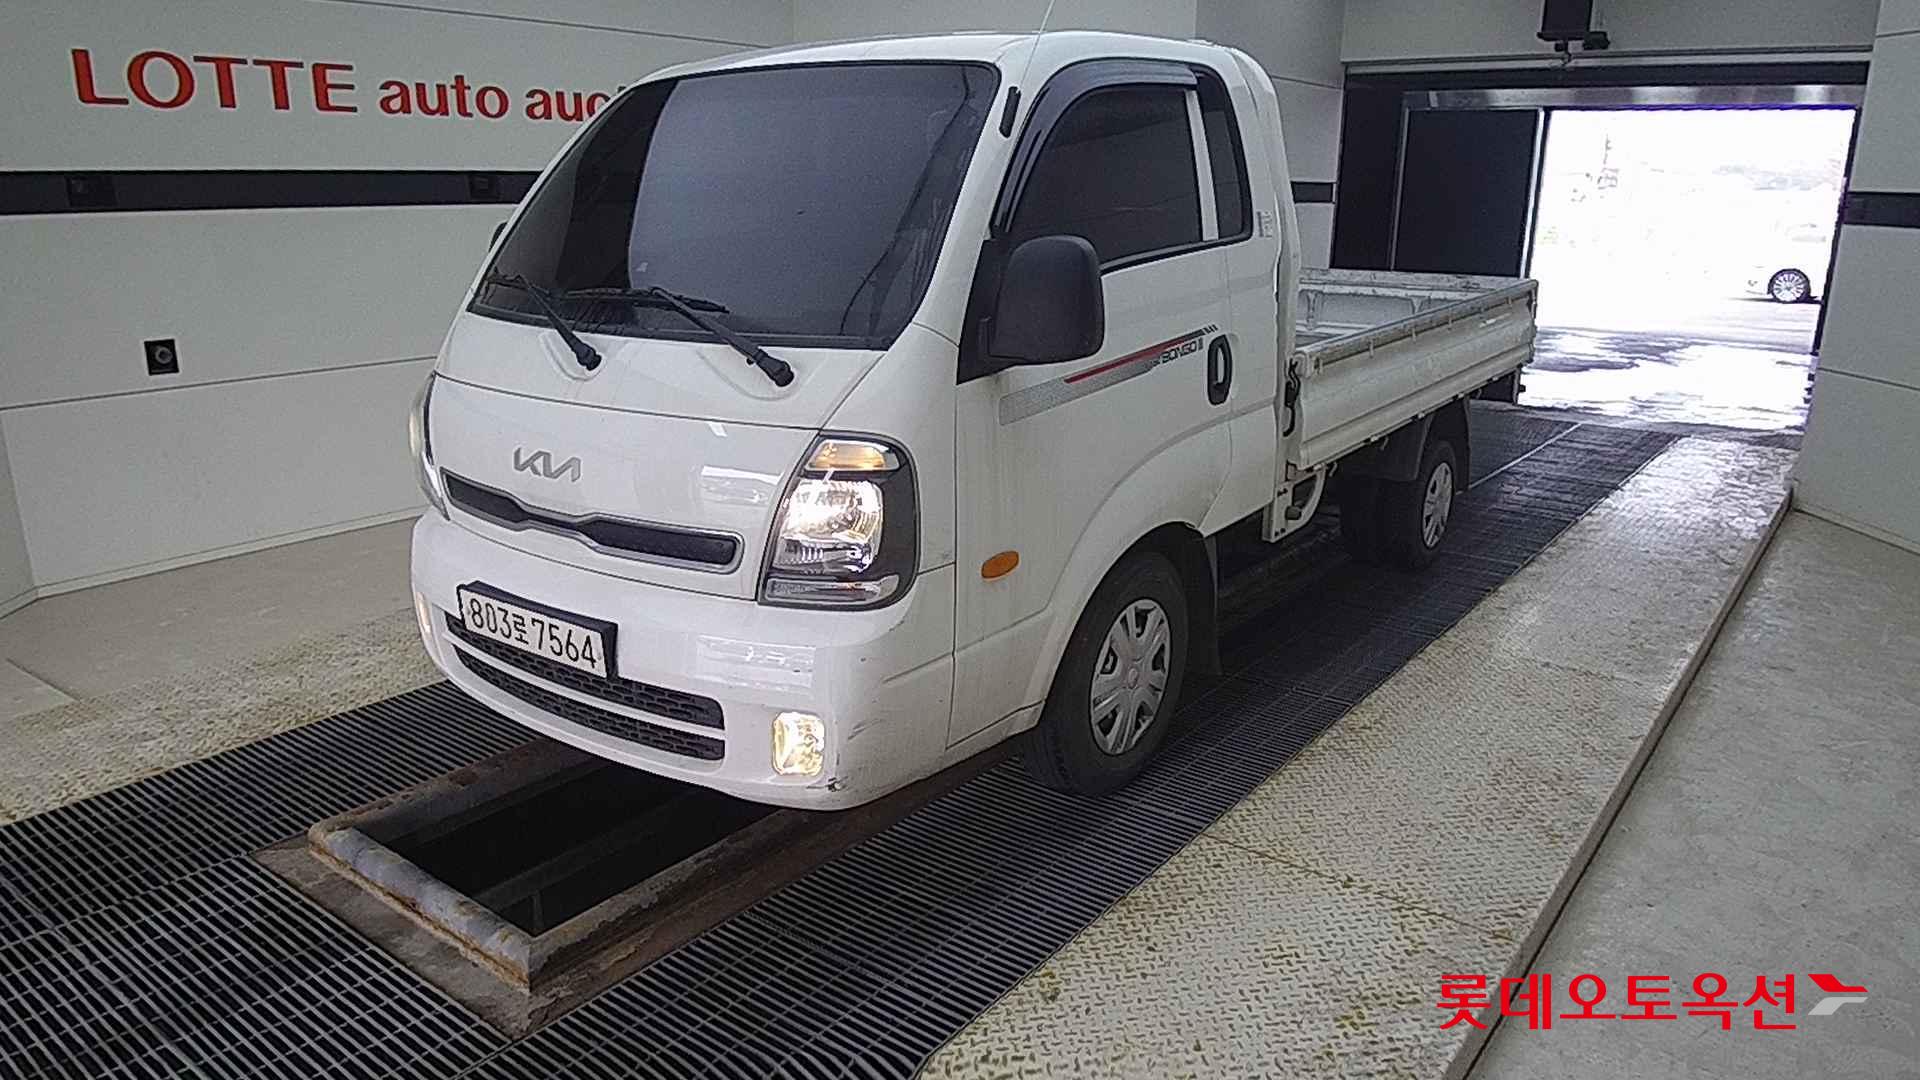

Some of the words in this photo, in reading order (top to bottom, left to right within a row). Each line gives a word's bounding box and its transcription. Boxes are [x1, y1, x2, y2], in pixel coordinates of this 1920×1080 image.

[72, 48, 358, 113] LOTTE
[378, 75, 510, 119] auto
[513, 447, 581, 482] KIA
[470, 598, 597, 668] 803로7564
